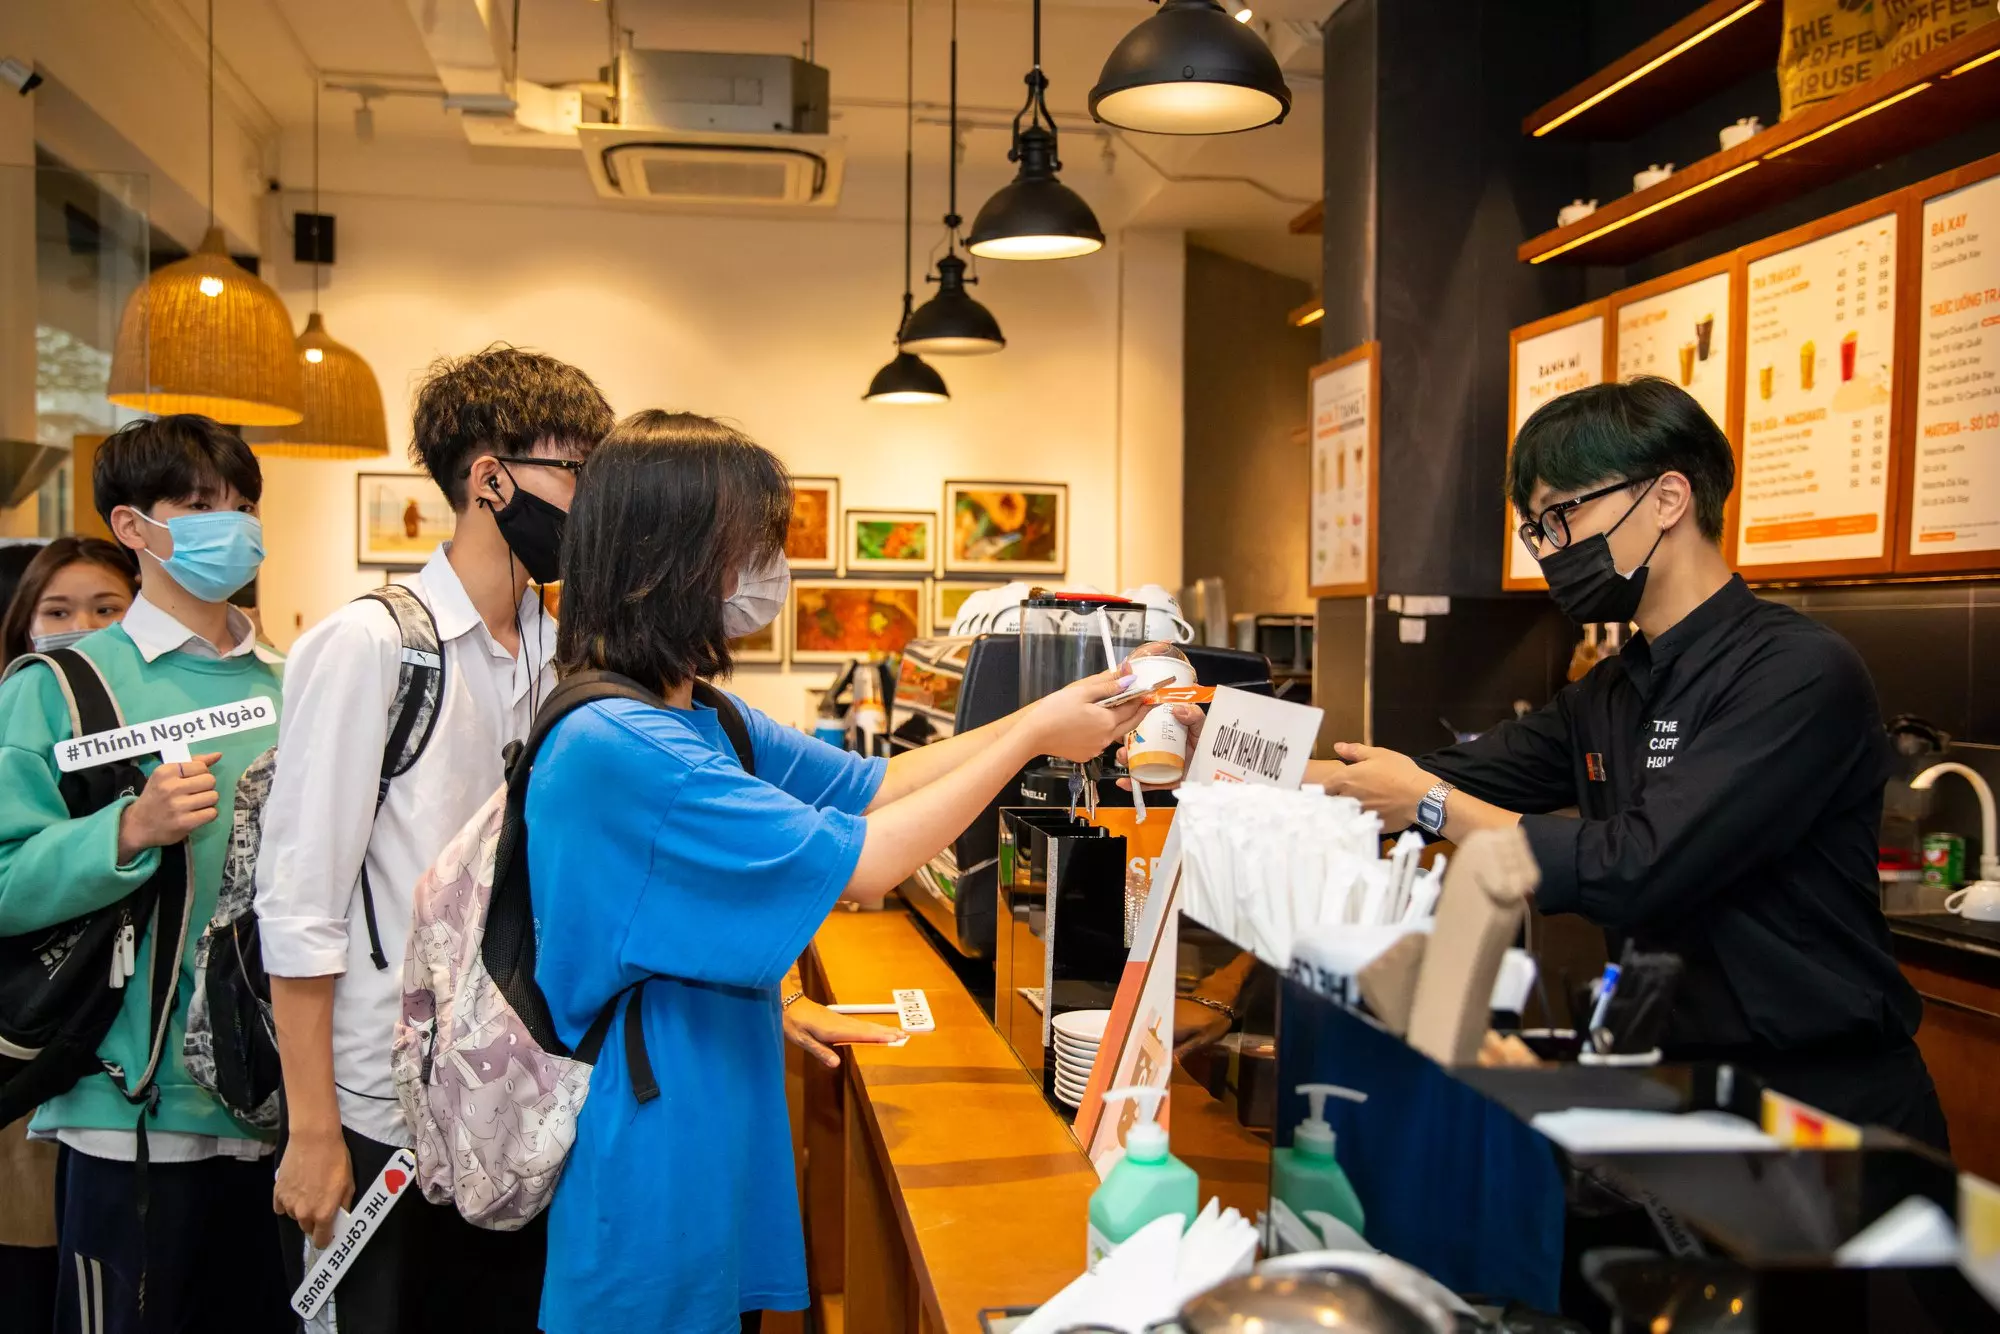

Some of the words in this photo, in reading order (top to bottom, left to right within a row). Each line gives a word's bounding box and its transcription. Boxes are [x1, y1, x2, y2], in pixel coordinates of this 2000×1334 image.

[1790, 14, 1833, 48] THE
[66, 729, 146, 762] #Thính
[149, 716, 206, 742] Ngọt
[208, 705, 266, 728] Ngào
[1653, 720, 1678, 733] THE
[398, 1155, 415, 1171] I
[364, 1191, 388, 1219] THE
[328, 1219, 367, 1270] COFFEE
[298, 1269, 333, 1313] HOUSE
